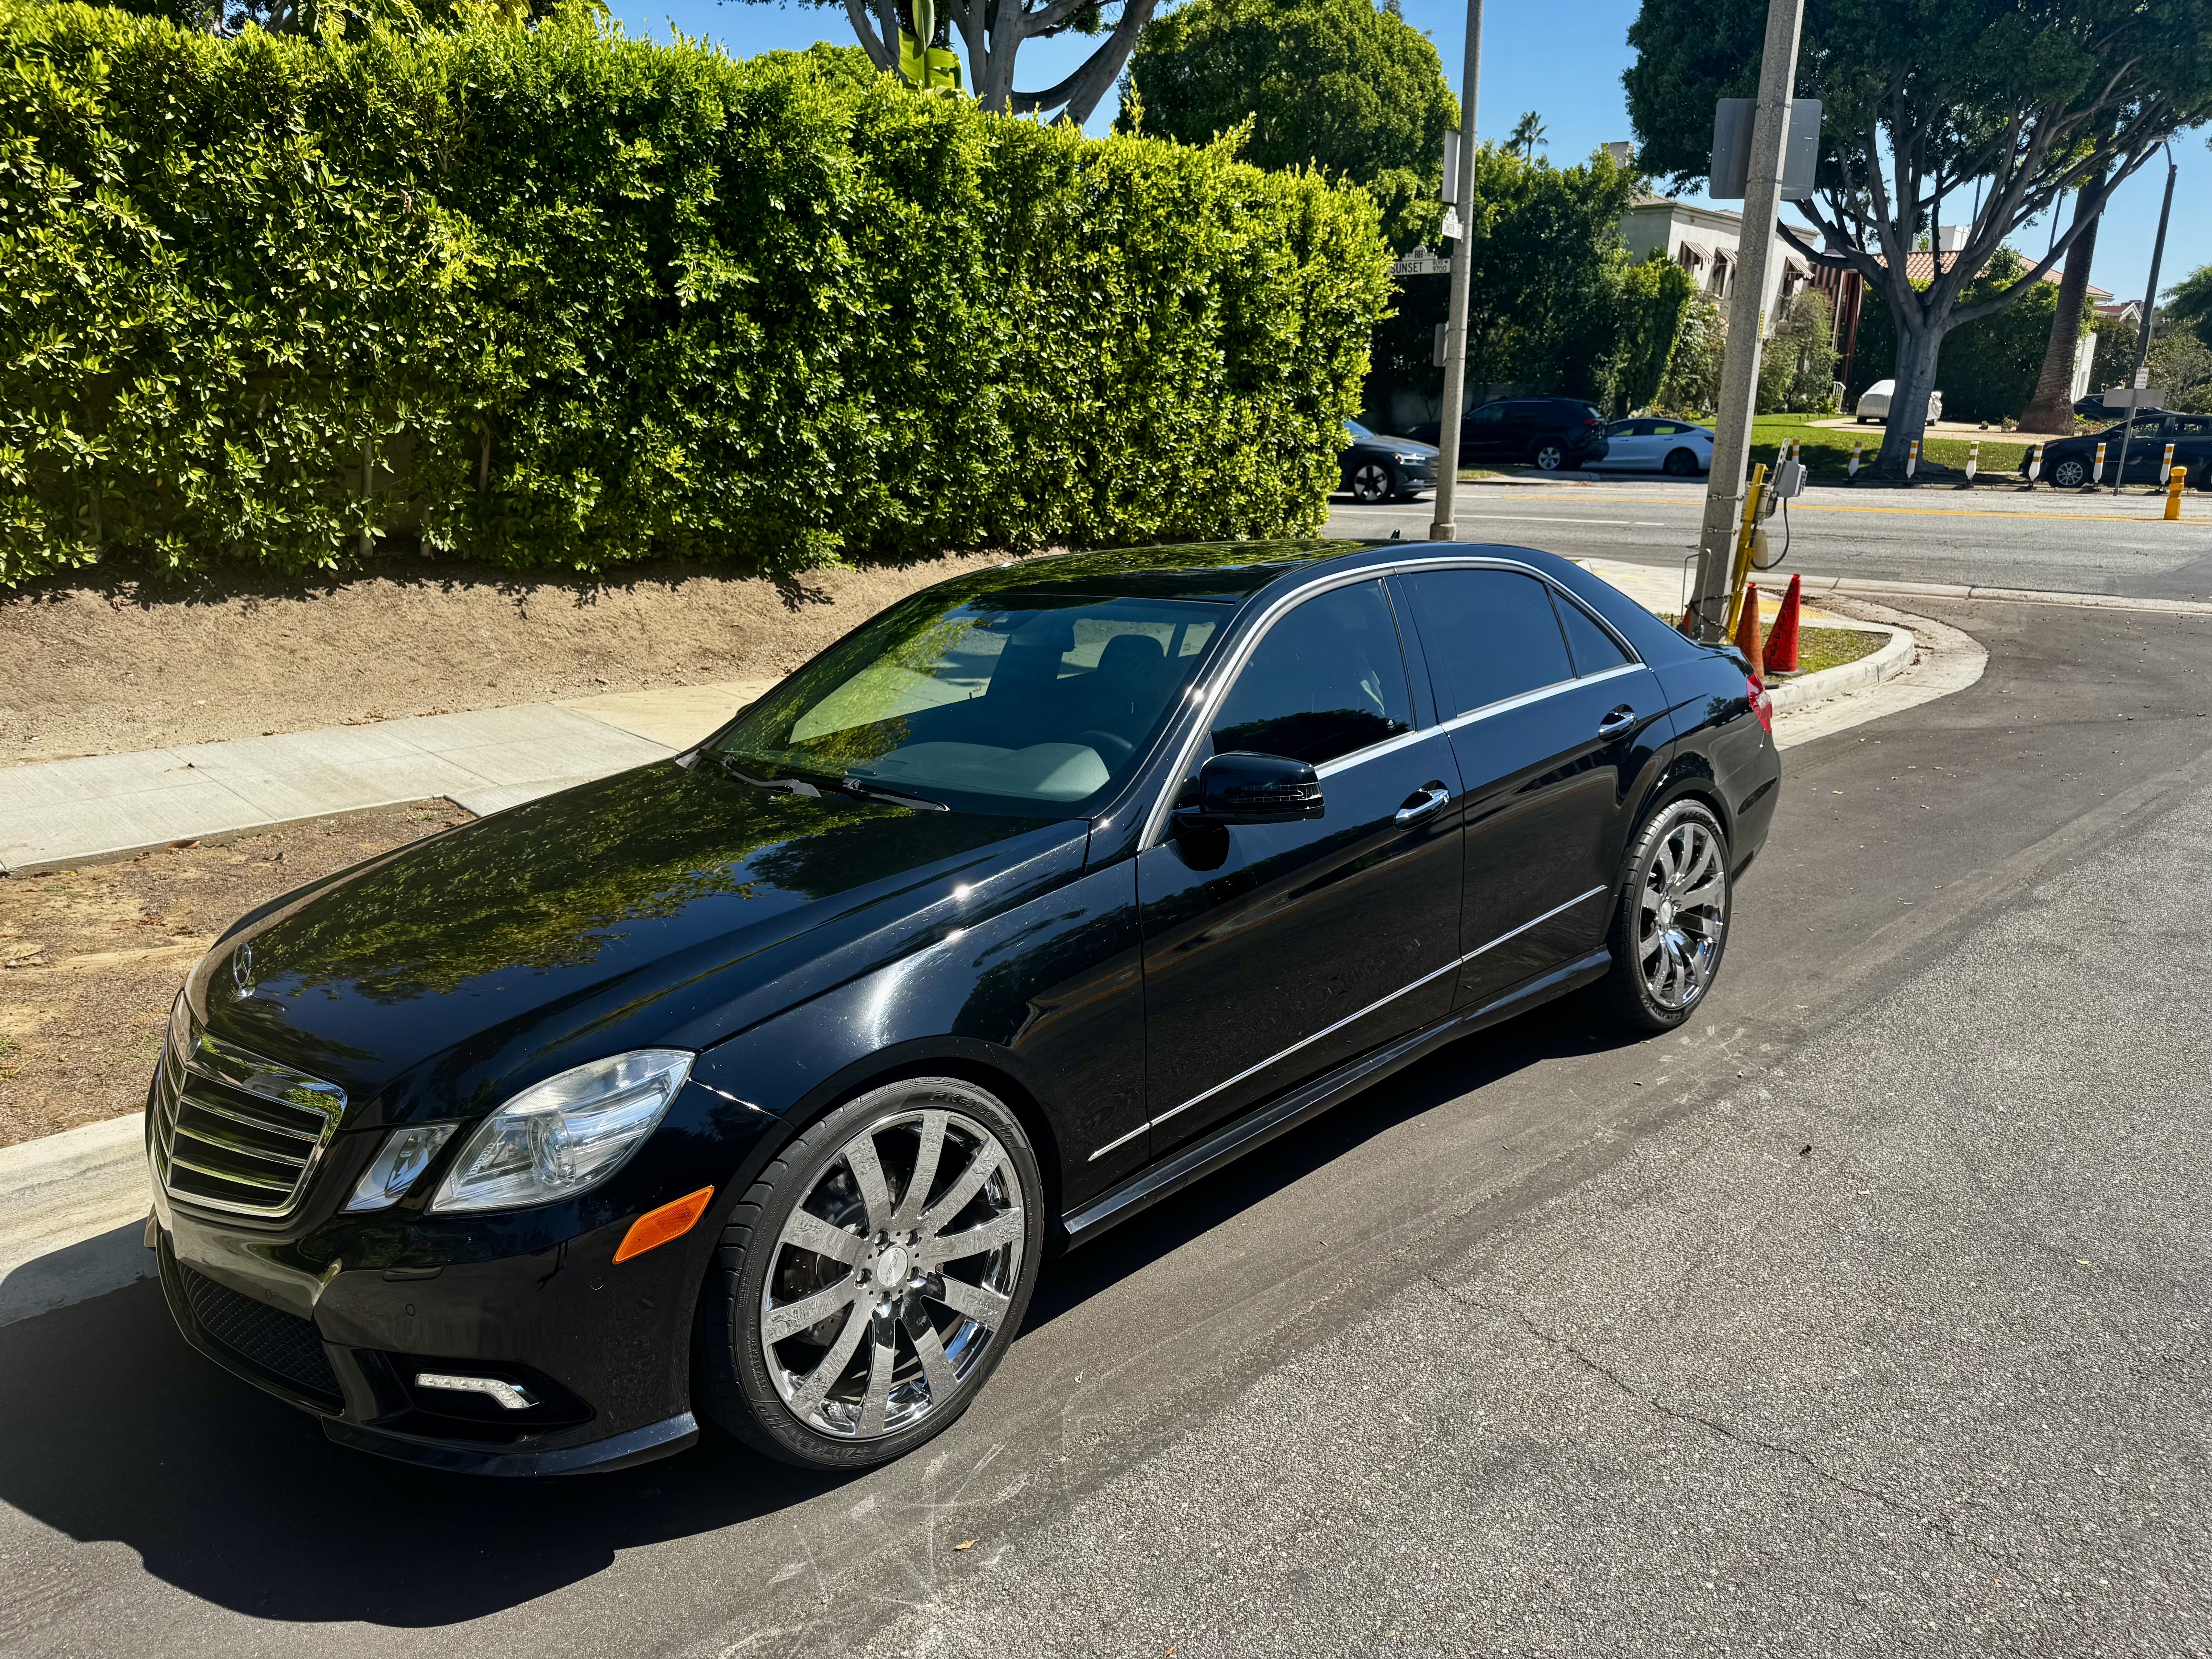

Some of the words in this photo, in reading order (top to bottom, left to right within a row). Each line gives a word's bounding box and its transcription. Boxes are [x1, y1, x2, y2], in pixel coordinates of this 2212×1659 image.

[1390, 262, 1423, 273] SUNSET
[929, 1091, 999, 1122] FK452
[788, 1429, 871, 1459] FALKEN
